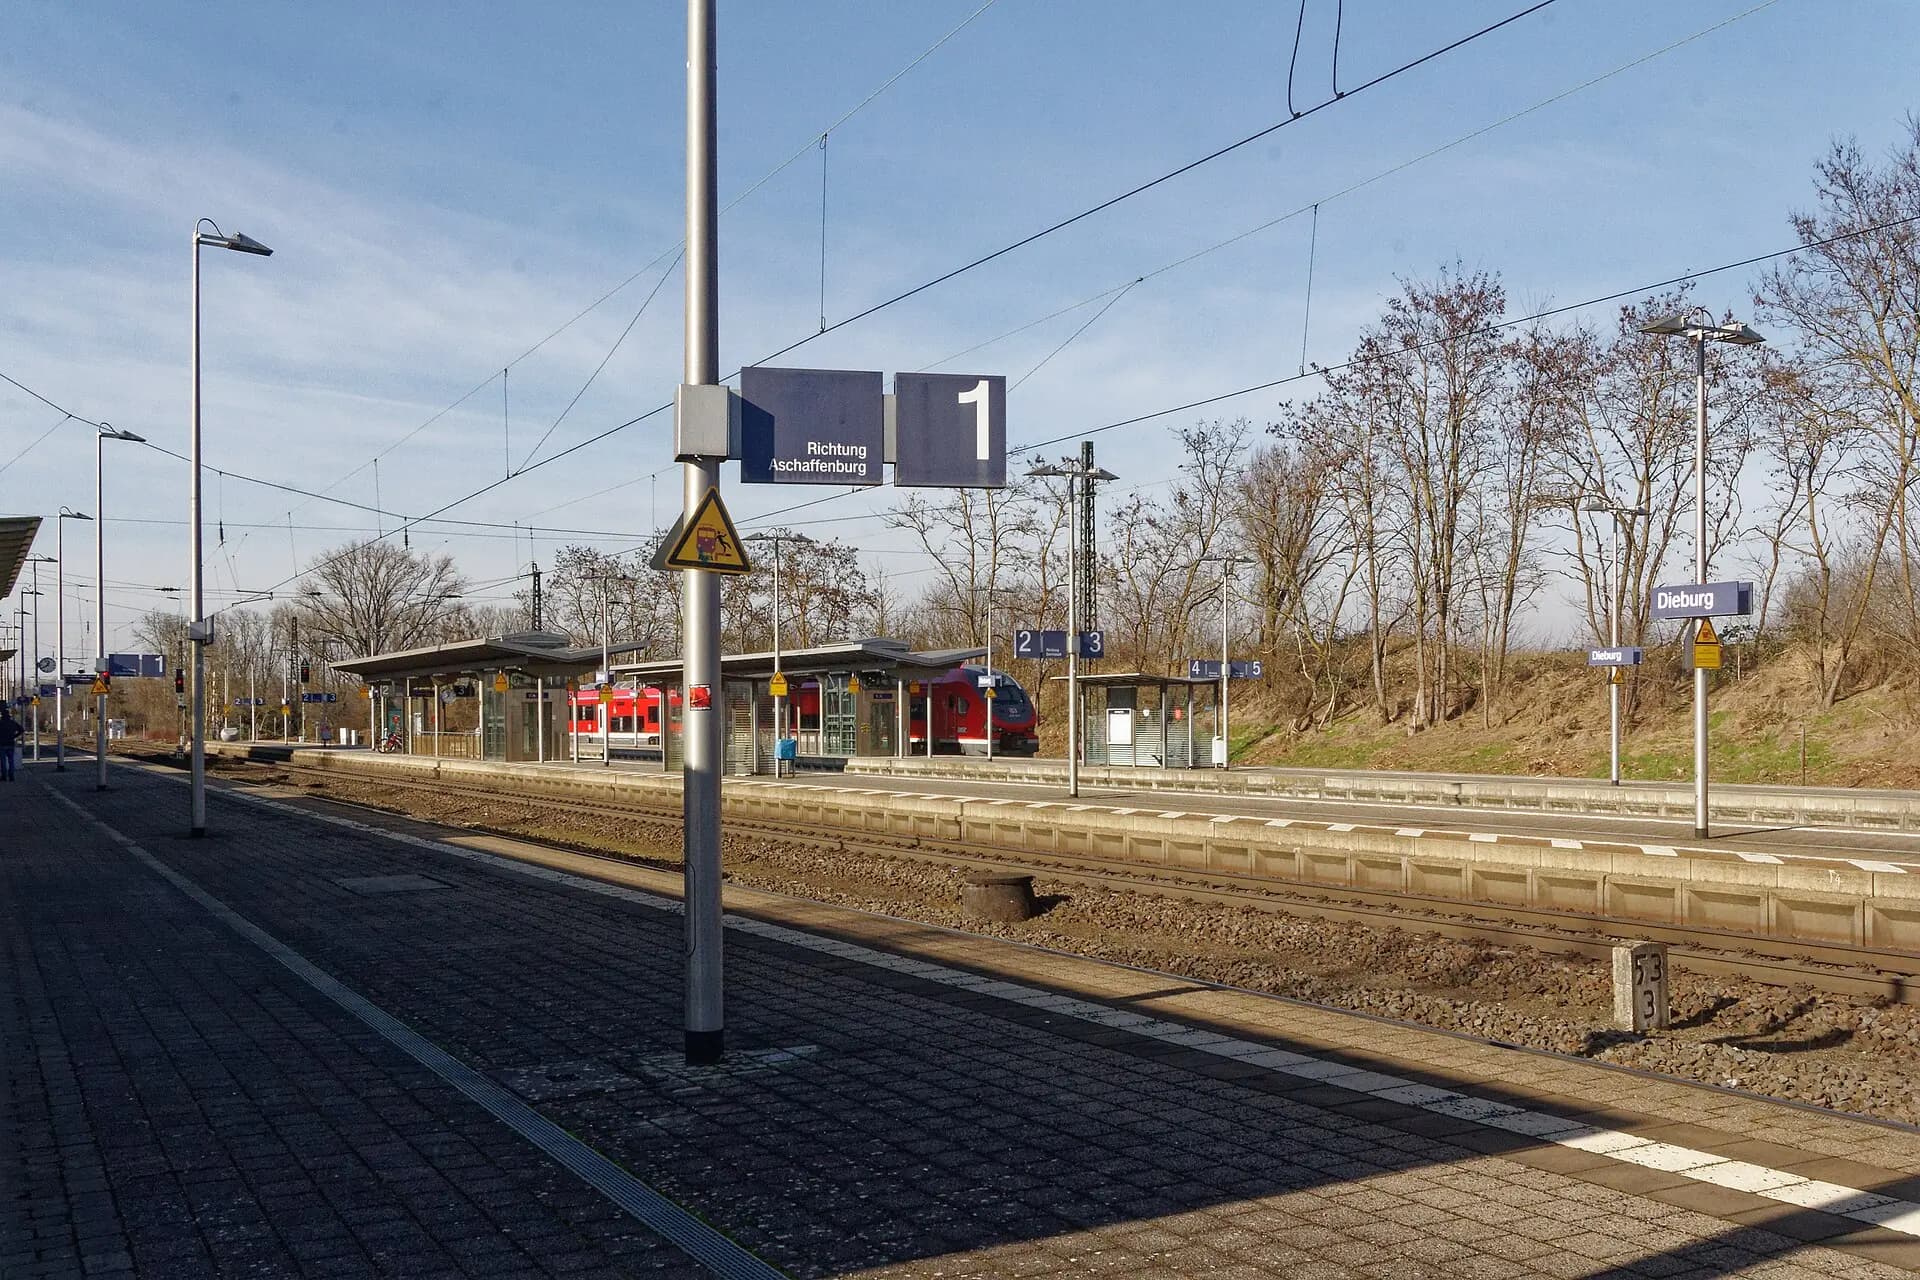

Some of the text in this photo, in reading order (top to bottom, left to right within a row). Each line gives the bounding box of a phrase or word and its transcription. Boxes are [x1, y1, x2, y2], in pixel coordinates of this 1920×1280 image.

[958, 380, 989, 460] 1
[807, 441, 867, 459] Richtung
[768, 458, 867, 476] Aschaffenburg
[1657, 591, 1714, 610] Dieburg
[1018, 630, 1032, 652] 2
[1089, 631, 1102, 653] 3
[155, 655, 163, 673] 1
[1591, 650, 1622, 661] Dieburg
[1191, 660, 1201, 675] 4
[1252, 661, 1261, 675] 5
[303, 693, 309, 701] 2
[330, 693, 336, 701] 3
[382, 684, 389, 695] 2
[459, 686, 465, 695] 3
[1634, 953, 1663, 985] 53
[1643, 989, 1655, 1019] 3
